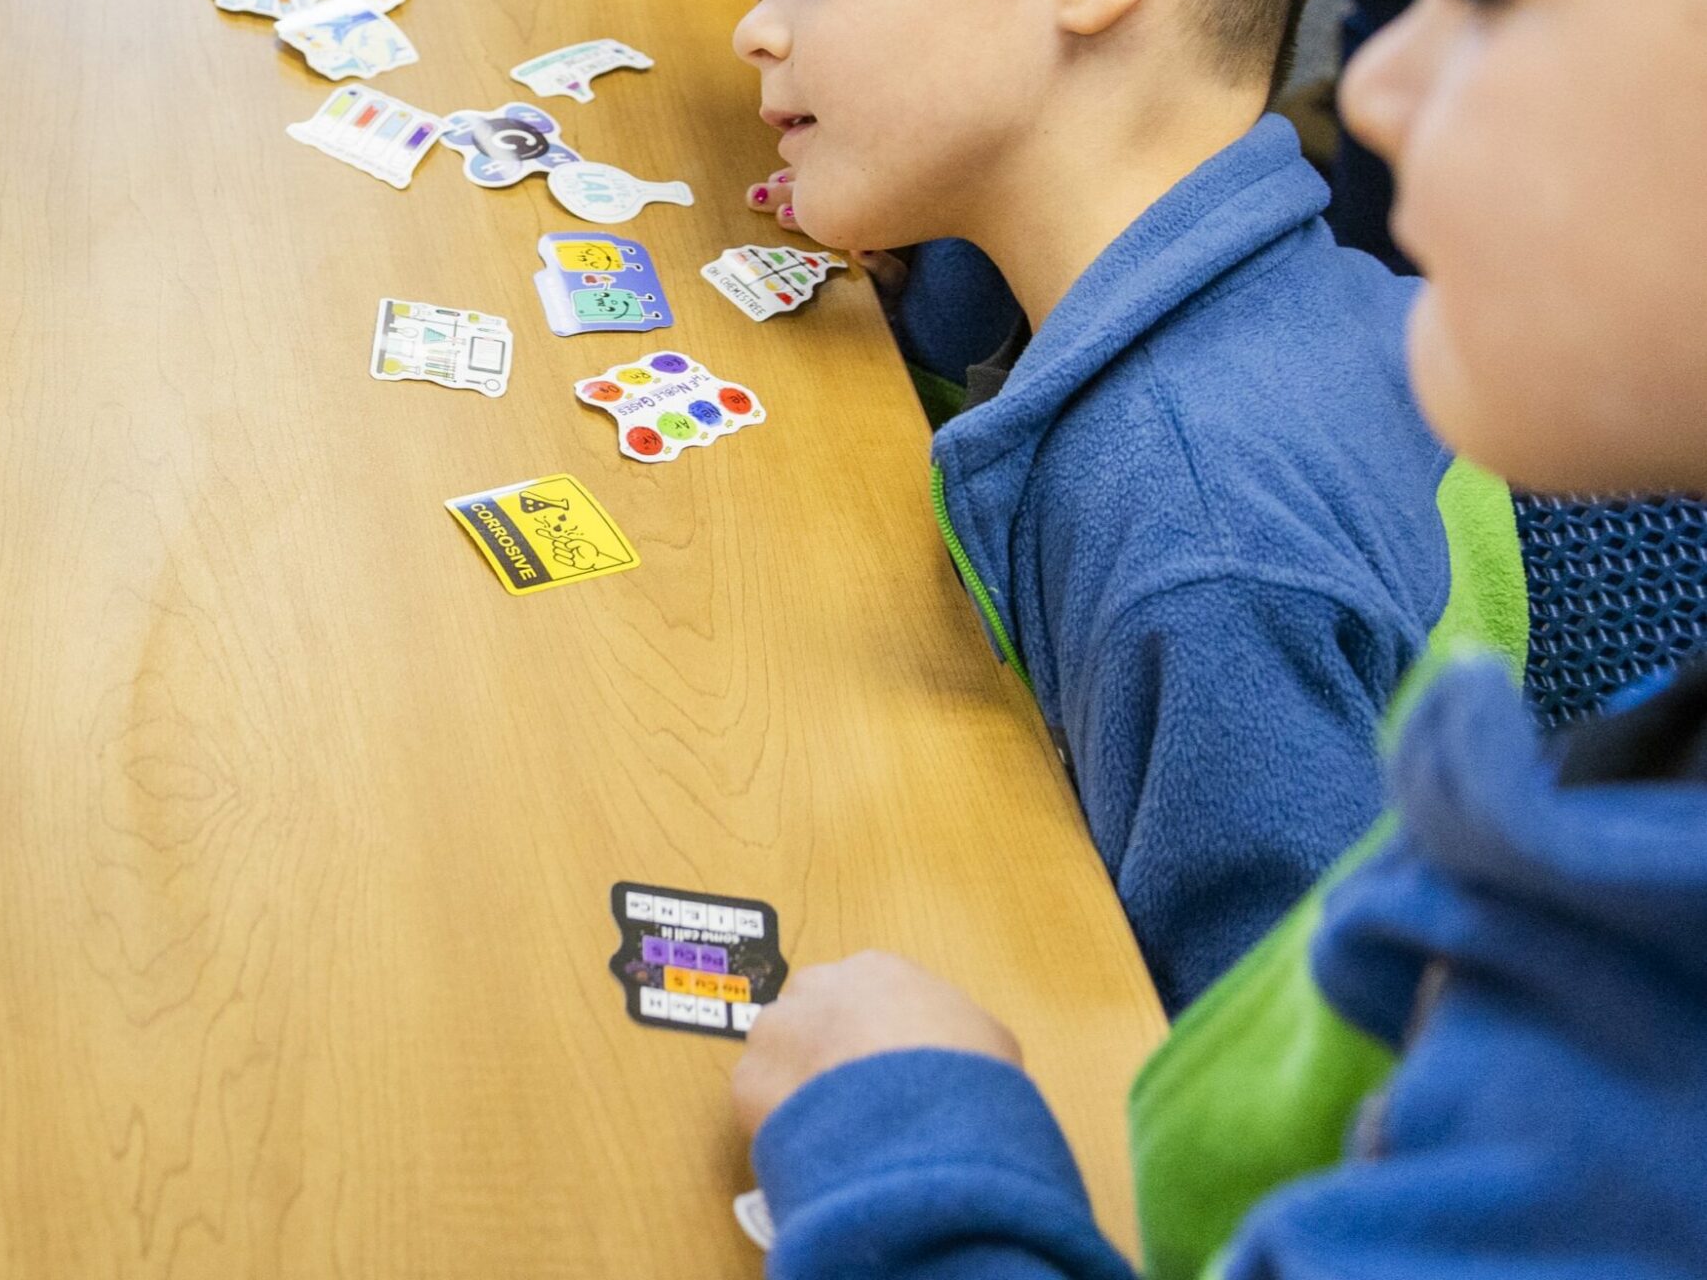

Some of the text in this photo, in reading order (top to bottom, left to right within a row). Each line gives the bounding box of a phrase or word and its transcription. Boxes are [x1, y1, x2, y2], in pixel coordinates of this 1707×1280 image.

[492, 129, 537, 150] C
[720, 277, 767, 317] CHEMISTREE
[619, 374, 711, 416] THE NOBLE GASES
[674, 419, 691, 431] Ar
[469, 502, 538, 581] CORROSIVE
